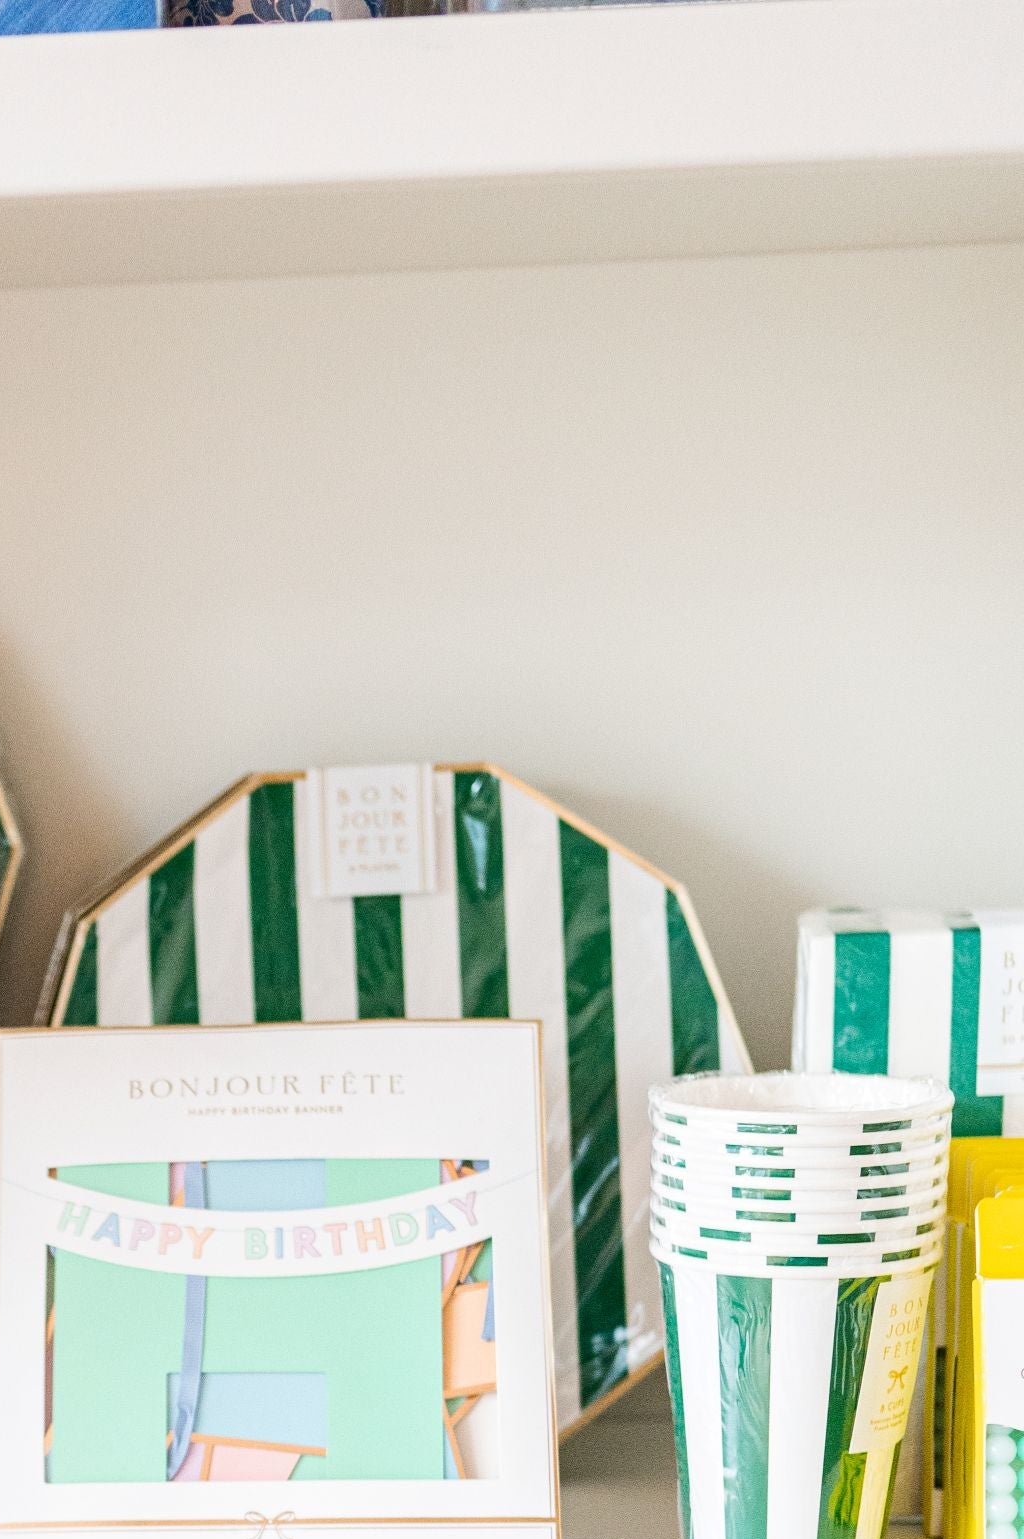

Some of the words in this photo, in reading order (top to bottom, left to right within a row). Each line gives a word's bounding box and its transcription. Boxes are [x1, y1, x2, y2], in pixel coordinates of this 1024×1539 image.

[337, 785, 407, 806] BON
[338, 809, 406, 831] JOUR
[128, 1074, 302, 1099] BONJOUR
[320, 1069, 406, 1097] FÊTE
[187, 1106, 226, 1117] HAPPY
[231, 1105, 289, 1116] BIRTHDAY
[294, 1104, 345, 1115] BANNER
[56, 1200, 215, 1260] HAPPY
[244, 1191, 478, 1261] BIRTHDAY
